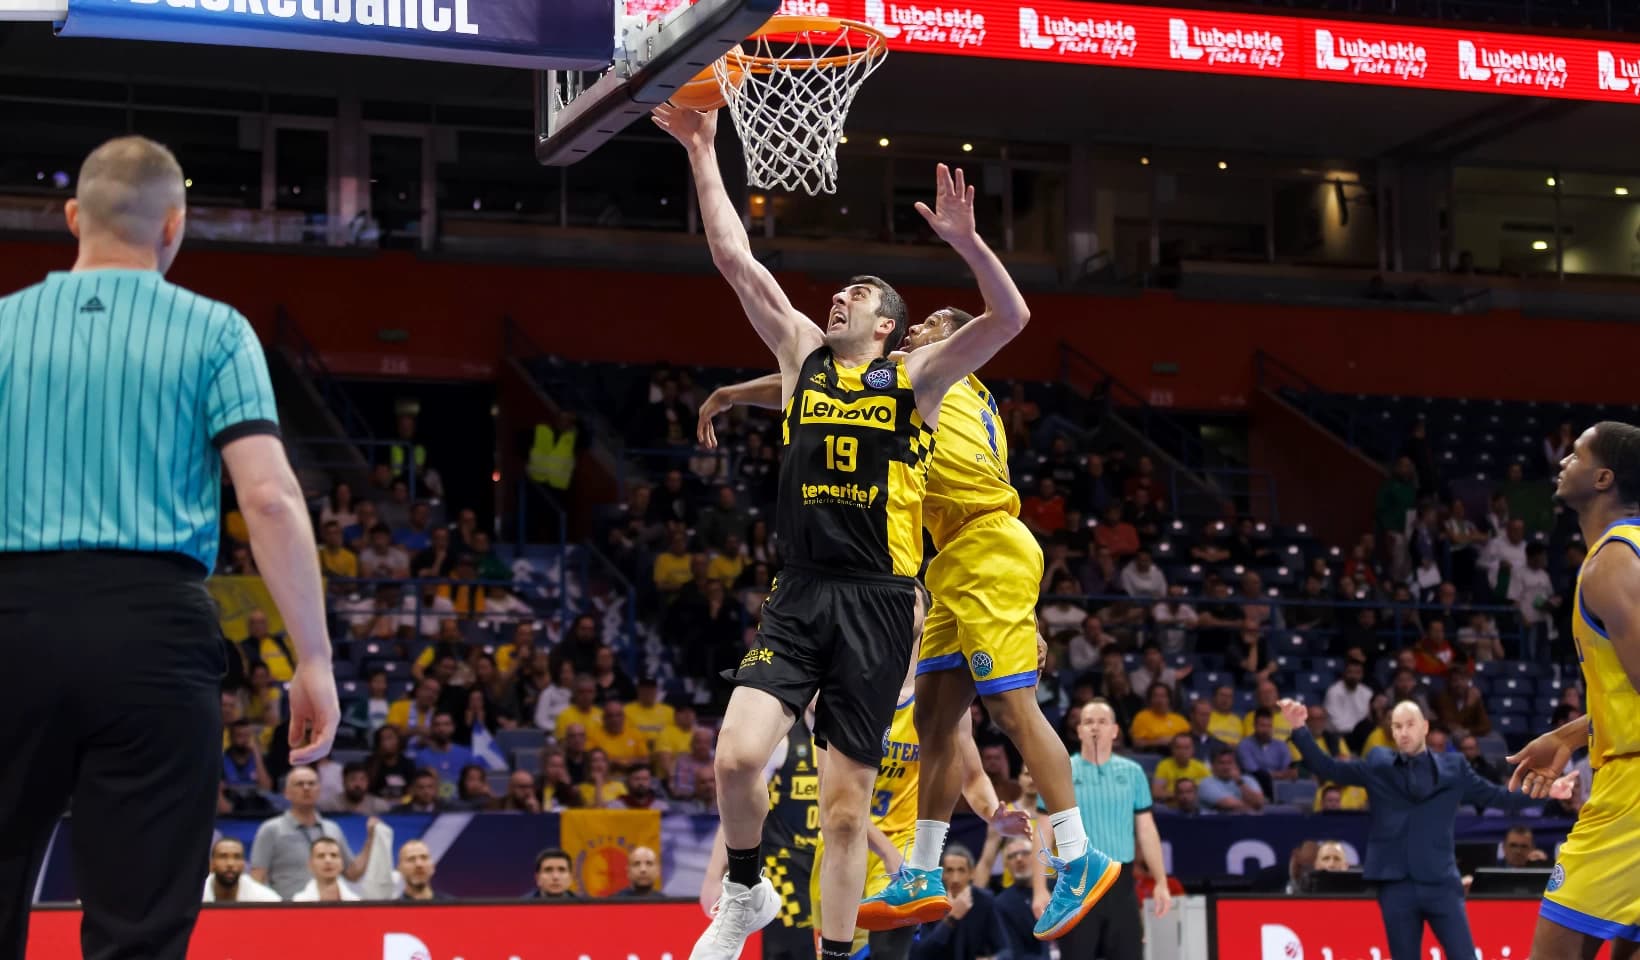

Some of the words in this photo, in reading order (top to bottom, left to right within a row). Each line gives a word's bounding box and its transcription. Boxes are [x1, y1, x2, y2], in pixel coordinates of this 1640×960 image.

[890, 4, 984, 29] lubelskie
[1043, 15, 1136, 40] lubelskie
[903, 25, 946, 43] Taste
[1056, 36, 1098, 55] Taste
[1193, 26, 1283, 51] lubelskie
[1205, 47, 1247, 65] Taste
[1338, 37, 1426, 61] lubelskie
[1481, 48, 1566, 72] lubelskie
[1351, 57, 1391, 76] Taste
[1493, 68, 1532, 86] Taste
[803, 396, 891, 423] Lenovo
[824, 435, 858, 472] 19
